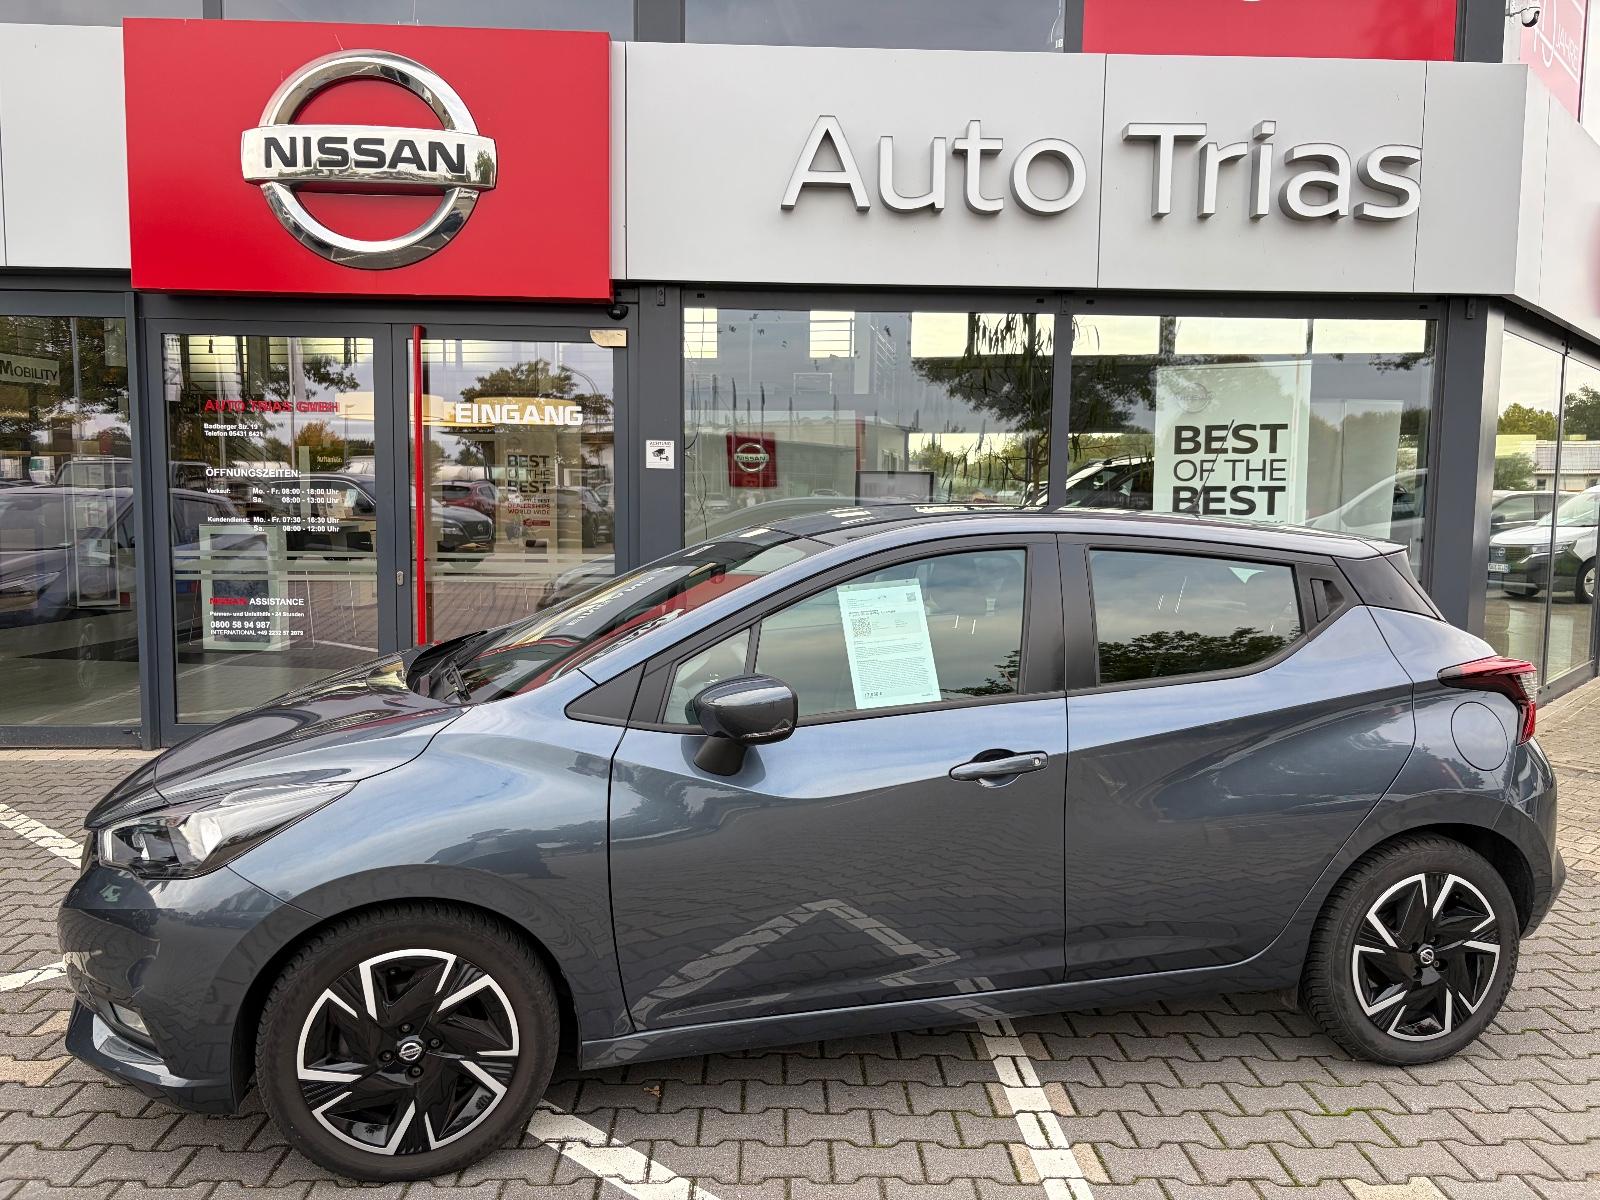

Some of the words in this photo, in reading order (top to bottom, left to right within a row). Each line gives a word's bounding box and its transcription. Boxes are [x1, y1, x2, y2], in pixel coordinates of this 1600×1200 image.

[263, 136, 466, 174] NISSAN
[781, 114, 1087, 217] Auto
[1122, 120, 1423, 222] Trias
[0, 360, 57, 380] MOBILITY
[204, 399, 246, 413] AUTO
[250, 400, 293, 413] TRIAS
[296, 401, 339, 413] GMBH
[455, 402, 583, 426] EINGANG
[1174, 423, 1288, 455] BEST
[507, 454, 550, 468] BEST
[205, 466, 302, 478] ÖFFNUNGSZEITEN:
[527, 469, 550, 480] THE
[1173, 458, 1217, 482] OF
[1224, 458, 1287, 482] THE
[507, 480, 551, 493] BEST
[1172, 485, 1287, 516] BEST
[249, 597, 305, 606] ASSISTANCE
[210, 621, 230, 629] 0800
[232, 621, 242, 629] 58
[243, 621, 254, 629] 94
[255, 621, 271, 629] 987
